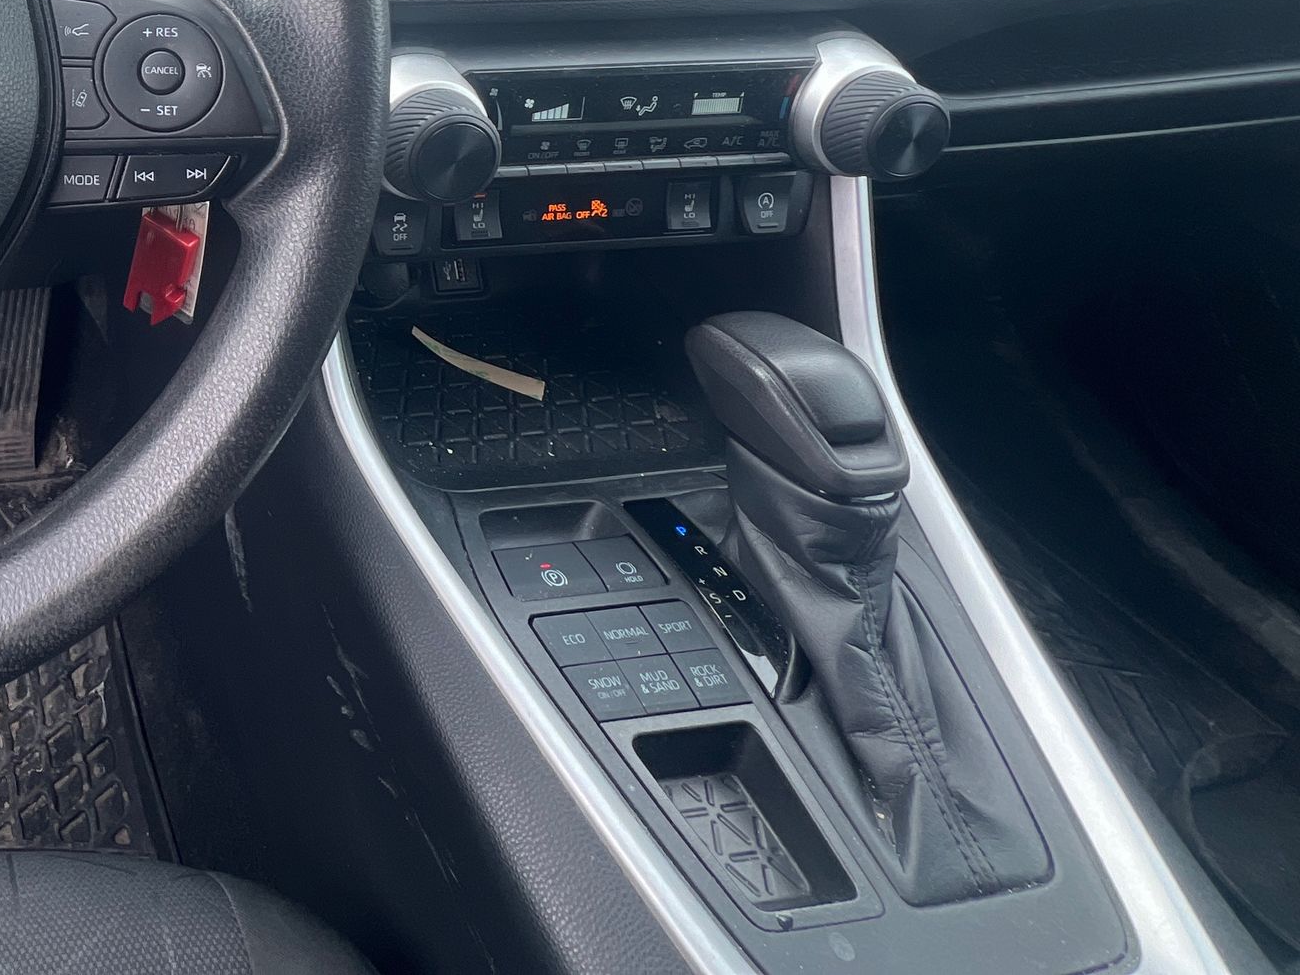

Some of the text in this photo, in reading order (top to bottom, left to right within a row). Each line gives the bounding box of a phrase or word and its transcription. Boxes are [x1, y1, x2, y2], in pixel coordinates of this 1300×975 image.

[155, 26, 178, 38] RES
[144, 65, 179, 76] CANCEL
[156, 105, 178, 116] SET
[722, 135, 744, 147] A/C
[63, 174, 100, 186] MODE
[548, 203, 567, 213] PASS
[760, 210, 774, 219] OFF
[541, 209, 591, 221] AIR BAG OFF
[393, 233, 408, 242] OFF
[694, 545, 708, 557] R
[713, 566, 728, 579] N
[709, 591, 722, 605] S
[732, 589, 747, 603] D
[603, 625, 650, 641] NORMAL
[658, 619, 692, 634] SPORT
[562, 632, 586, 646] ECO
[639, 670, 668, 683] MUD
[689, 663, 719, 677] ROCK
[587, 675, 622, 690] SNOW
[649, 679, 681, 693] SAND
[702, 673, 728, 687] DIRT
